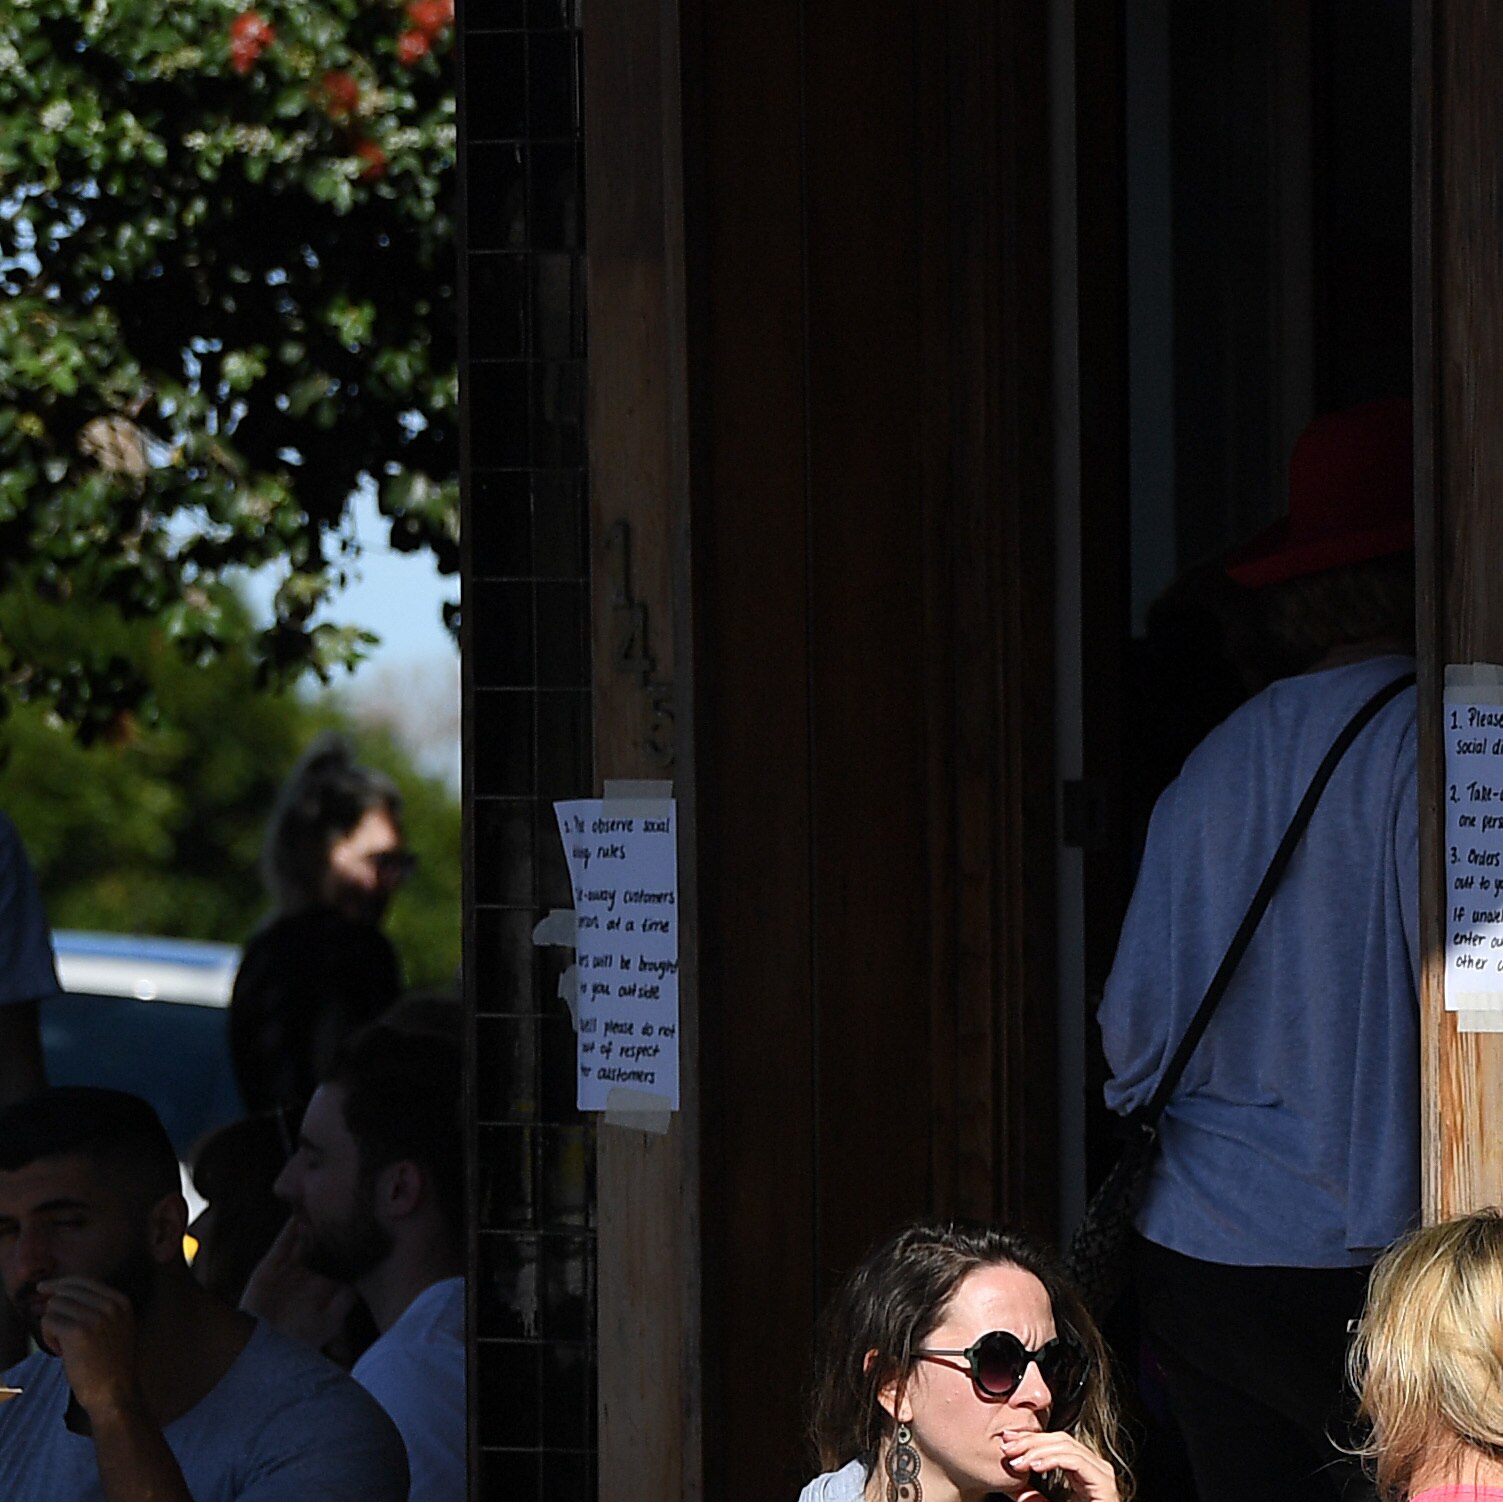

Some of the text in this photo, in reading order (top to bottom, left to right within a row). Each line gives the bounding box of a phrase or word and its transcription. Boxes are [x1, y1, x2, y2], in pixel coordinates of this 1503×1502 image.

[1450, 709, 1463, 730] 1.
[1456, 737, 1487, 756] social
[1450, 784, 1461, 804] 2.
[591, 817, 635, 835] observe
[1459, 814, 1476, 828] one
[596, 843, 627, 861] rules
[1450, 846, 1461, 864] 3.
[1467, 848, 1501, 868] Orders
[1454, 876, 1475, 891] out
[1479, 875, 1491, 891] to
[623, 888, 676, 905] customers
[1453, 905, 1466, 923] If
[606, 916, 621, 932] at
[625, 920, 635, 932] a
[642, 918, 670, 934] time
[1453, 930, 1487, 947] enter
[620, 954, 632, 971] be
[1455, 953, 1489, 971] other
[590, 982, 612, 1003] you
[603, 1018, 635, 1038] please
[641, 1021, 655, 1037] do
[658, 1023, 677, 1039] not
[600, 1041, 613, 1061] of
[619, 1044, 661, 1063] respect
[597, 1067, 656, 1085] customers
